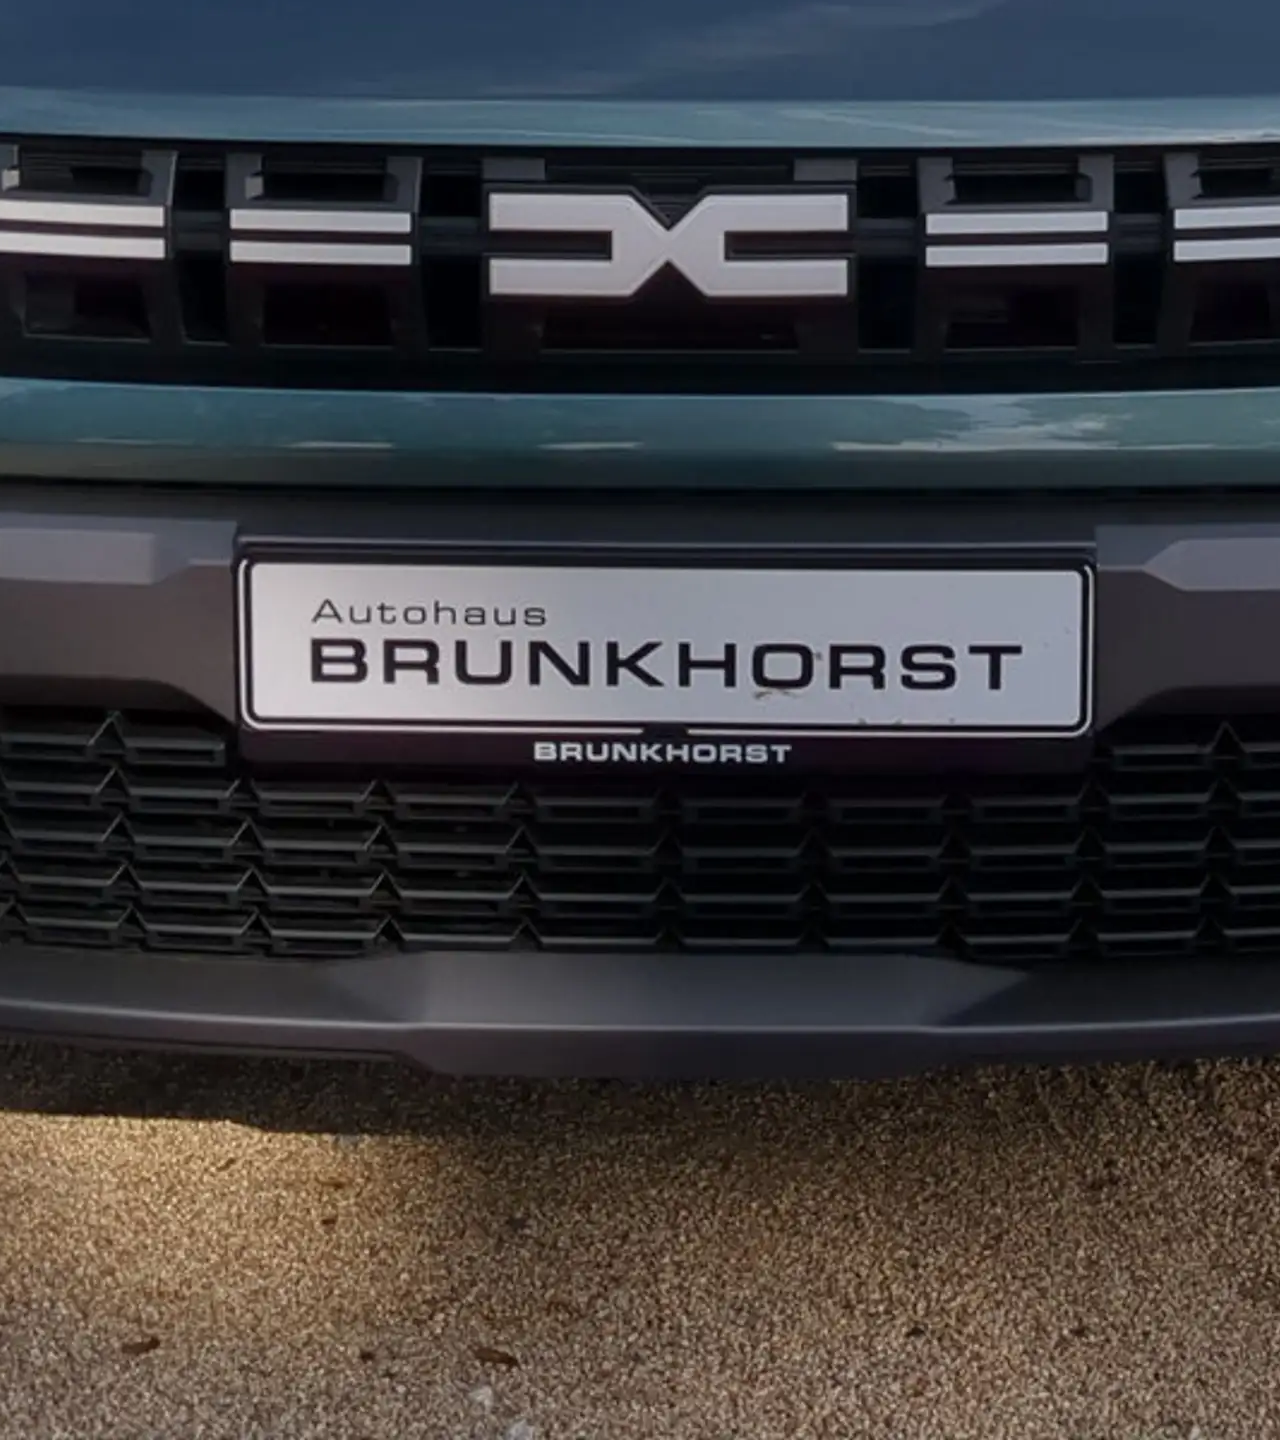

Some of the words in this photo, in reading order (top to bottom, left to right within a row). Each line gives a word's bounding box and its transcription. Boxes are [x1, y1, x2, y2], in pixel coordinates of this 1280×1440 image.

[311, 597, 548, 628] Autohaus
[310, 638, 1024, 692] BRUNKHORST
[532, 740, 793, 764] BRUNKHORST
